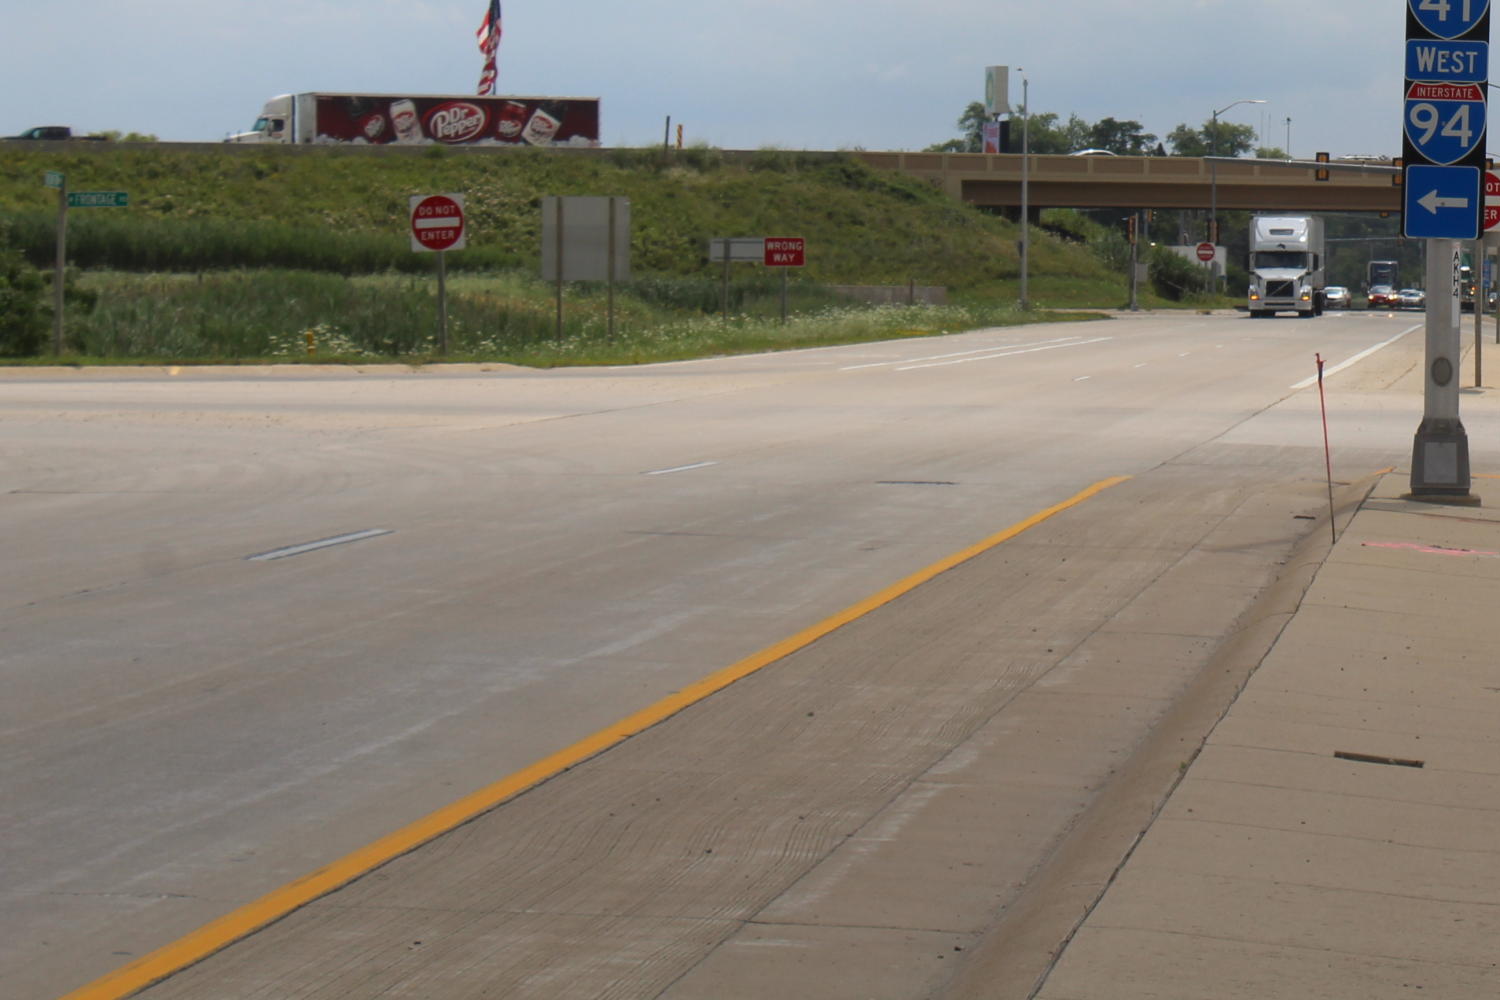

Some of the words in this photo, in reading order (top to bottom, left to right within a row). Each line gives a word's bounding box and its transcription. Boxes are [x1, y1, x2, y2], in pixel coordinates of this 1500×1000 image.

[1415, 46, 1478, 73] WEST
[1416, 86, 1473, 99] INTERSTATE
[449, 107, 469, 121] Dr
[431, 111, 481, 138] Pepper
[1409, 102, 1472, 148] 94
[1486, 182, 1500, 192] OT
[418, 206, 433, 216] DO
[435, 205, 455, 215] NOT
[421, 230, 454, 241] ENTER
[767, 241, 803, 251] WRONG
[772, 253, 796, 263] WAY
